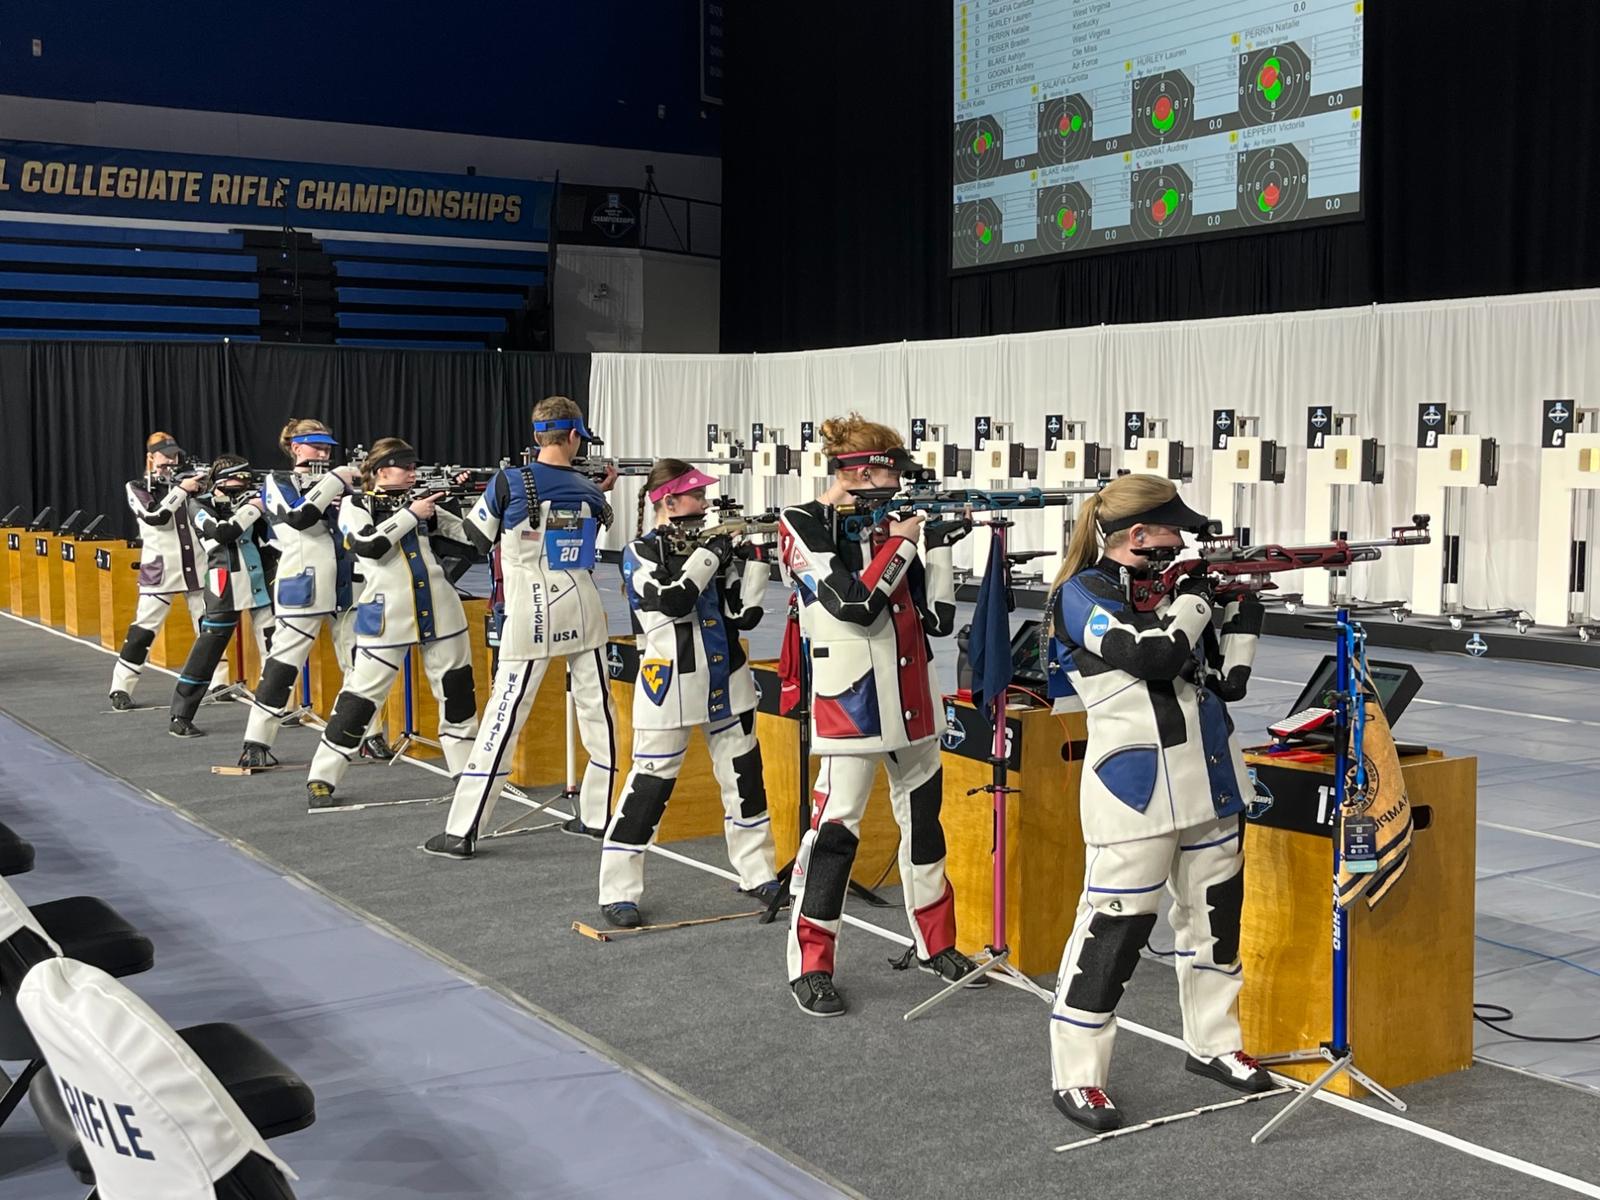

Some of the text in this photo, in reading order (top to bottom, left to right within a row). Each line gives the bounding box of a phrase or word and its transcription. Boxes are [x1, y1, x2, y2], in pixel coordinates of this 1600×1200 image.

[1293, 2, 1306, 12] 0.0
[1328, 93, 1343, 106] 0.0
[1209, 118, 1222, 130] 0.0
[1105, 139, 1118, 151] 0.0
[20, 160, 203, 203] COLLEGIATE
[209, 173, 291, 208] RIFLE
[296, 179, 522, 223] CHAMPIONSHIPS
[1325, 198, 1340, 210] 0.0
[1207, 214, 1221, 226] 0.0
[1105, 230, 1117, 241] 0.0
[1051, 437, 1057, 449] 7
[1130, 435, 1137, 448] 8
[1218, 434, 1226, 448] 9
[1313, 432, 1323, 447] A
[1425, 430, 1436, 446] B
[1552, 429, 1563, 446] C
[560, 547, 579, 562] 20
[532, 583, 543, 644] PEISER
[553, 629, 578, 642] USA
[483, 672, 518, 752] WILDCATS
[60, 1076, 156, 1161] RIFLE
